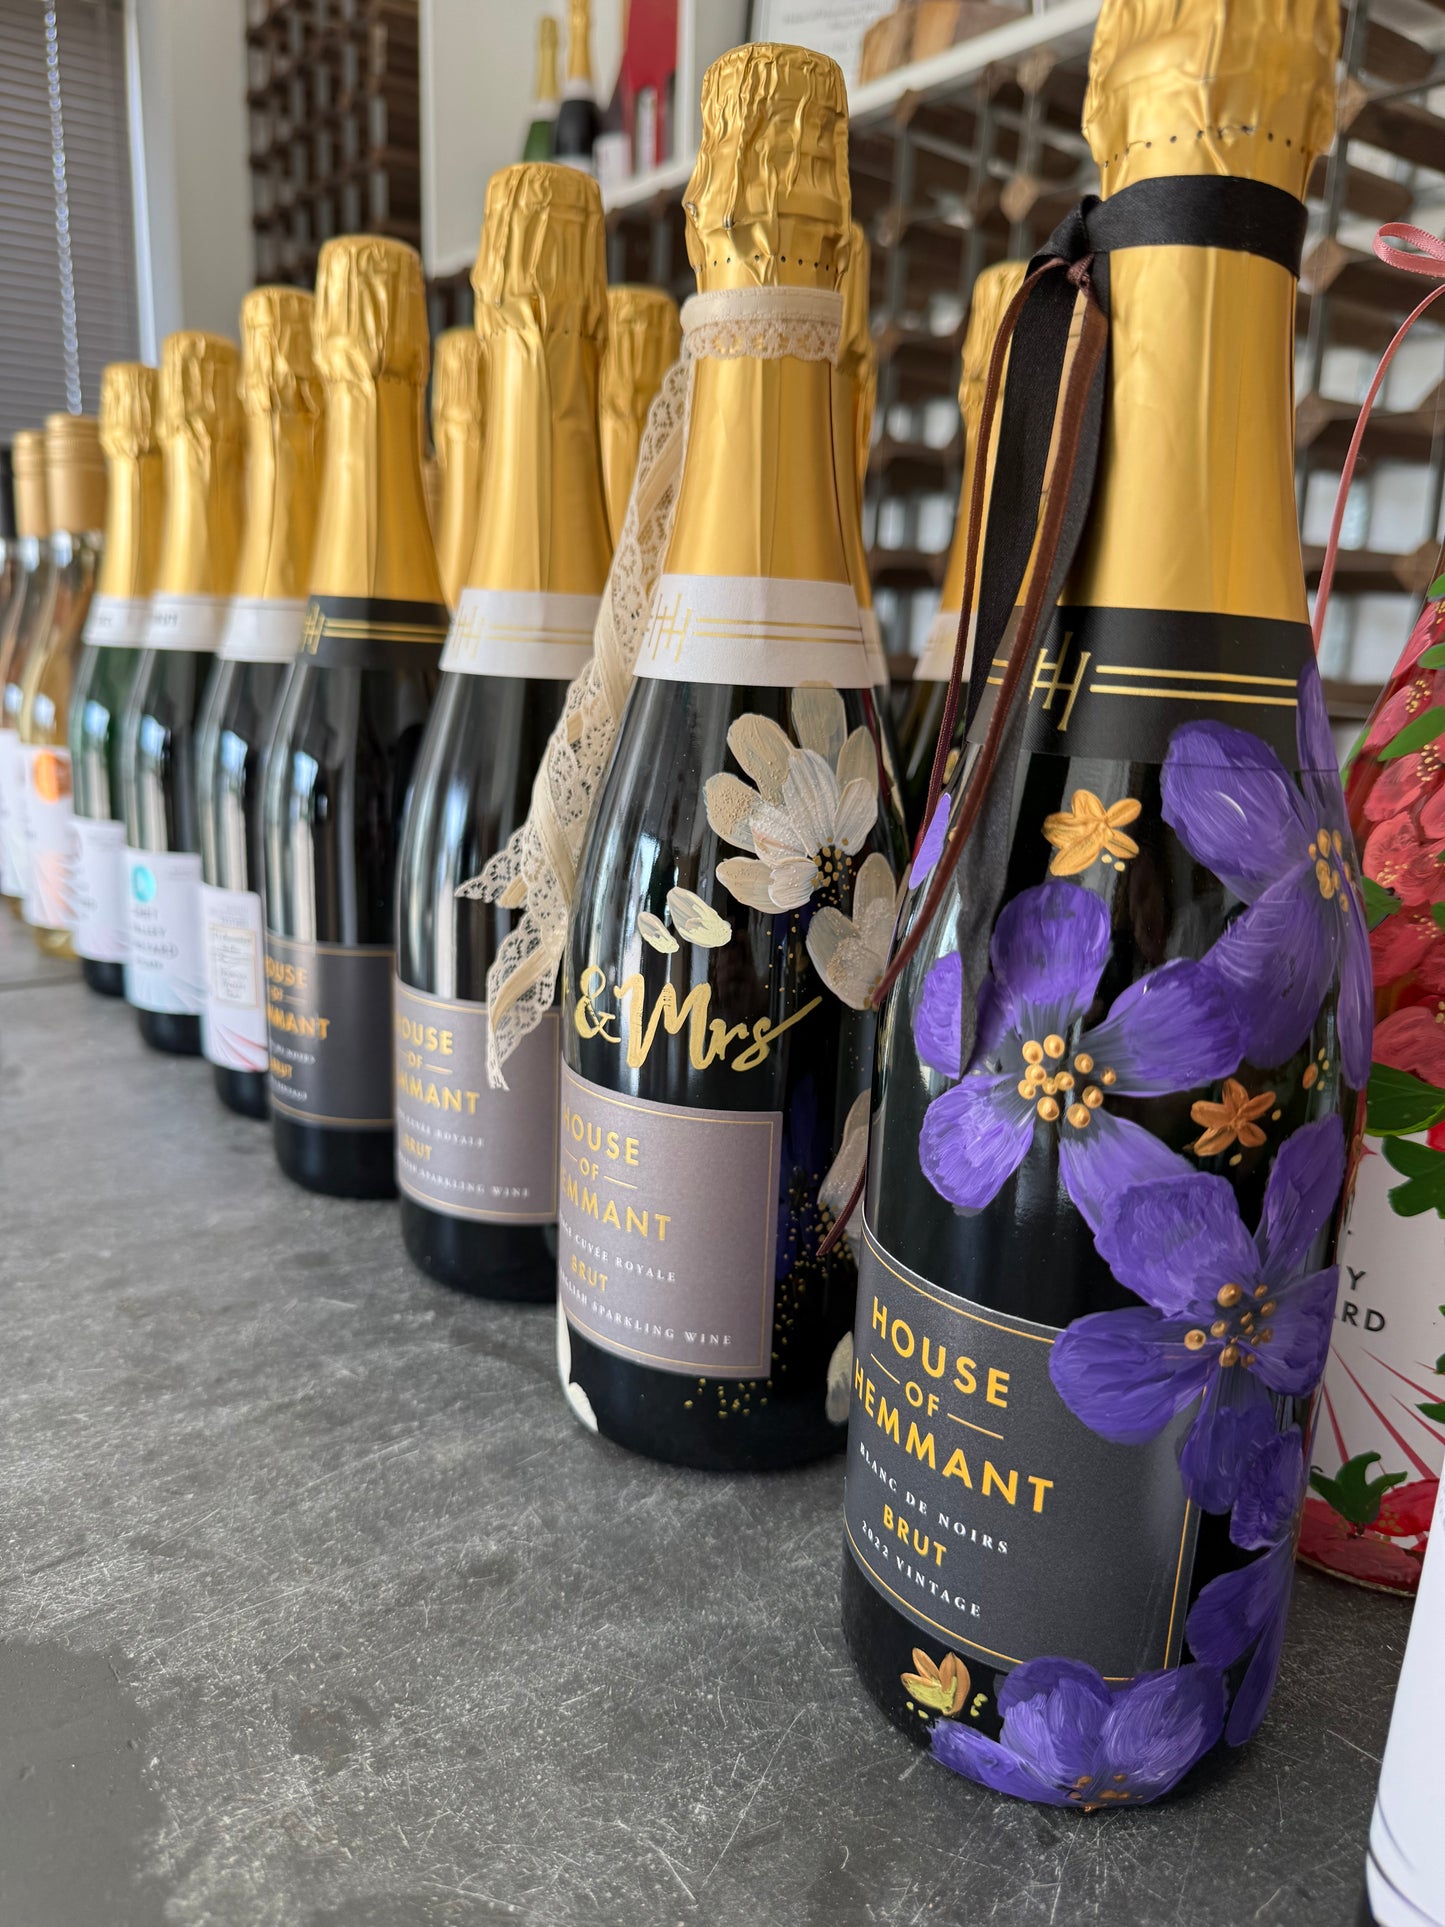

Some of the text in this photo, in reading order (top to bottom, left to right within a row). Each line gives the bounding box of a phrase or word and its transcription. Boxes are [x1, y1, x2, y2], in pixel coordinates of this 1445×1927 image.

[575, 964, 822, 1072] & Mrs
[562, 1101, 640, 1166] HOUSE
[579, 1157, 599, 1180] OF
[571, 1254, 608, 1293] BRUT
[615, 1256, 676, 1282] ROYALE
[592, 1297, 675, 1338] SPARKLING
[684, 1330, 733, 1345] WINE
[872, 1296, 1010, 1408] HOUSE
[905, 1381, 939, 1417] OF
[854, 1358, 1054, 1514] HEMMANT
[860, 1441, 1008, 1555] BLANC DE NOIRS
[883, 1503, 947, 1567] BRUT
[862, 1519, 981, 1618] 2022 VINTAGE
